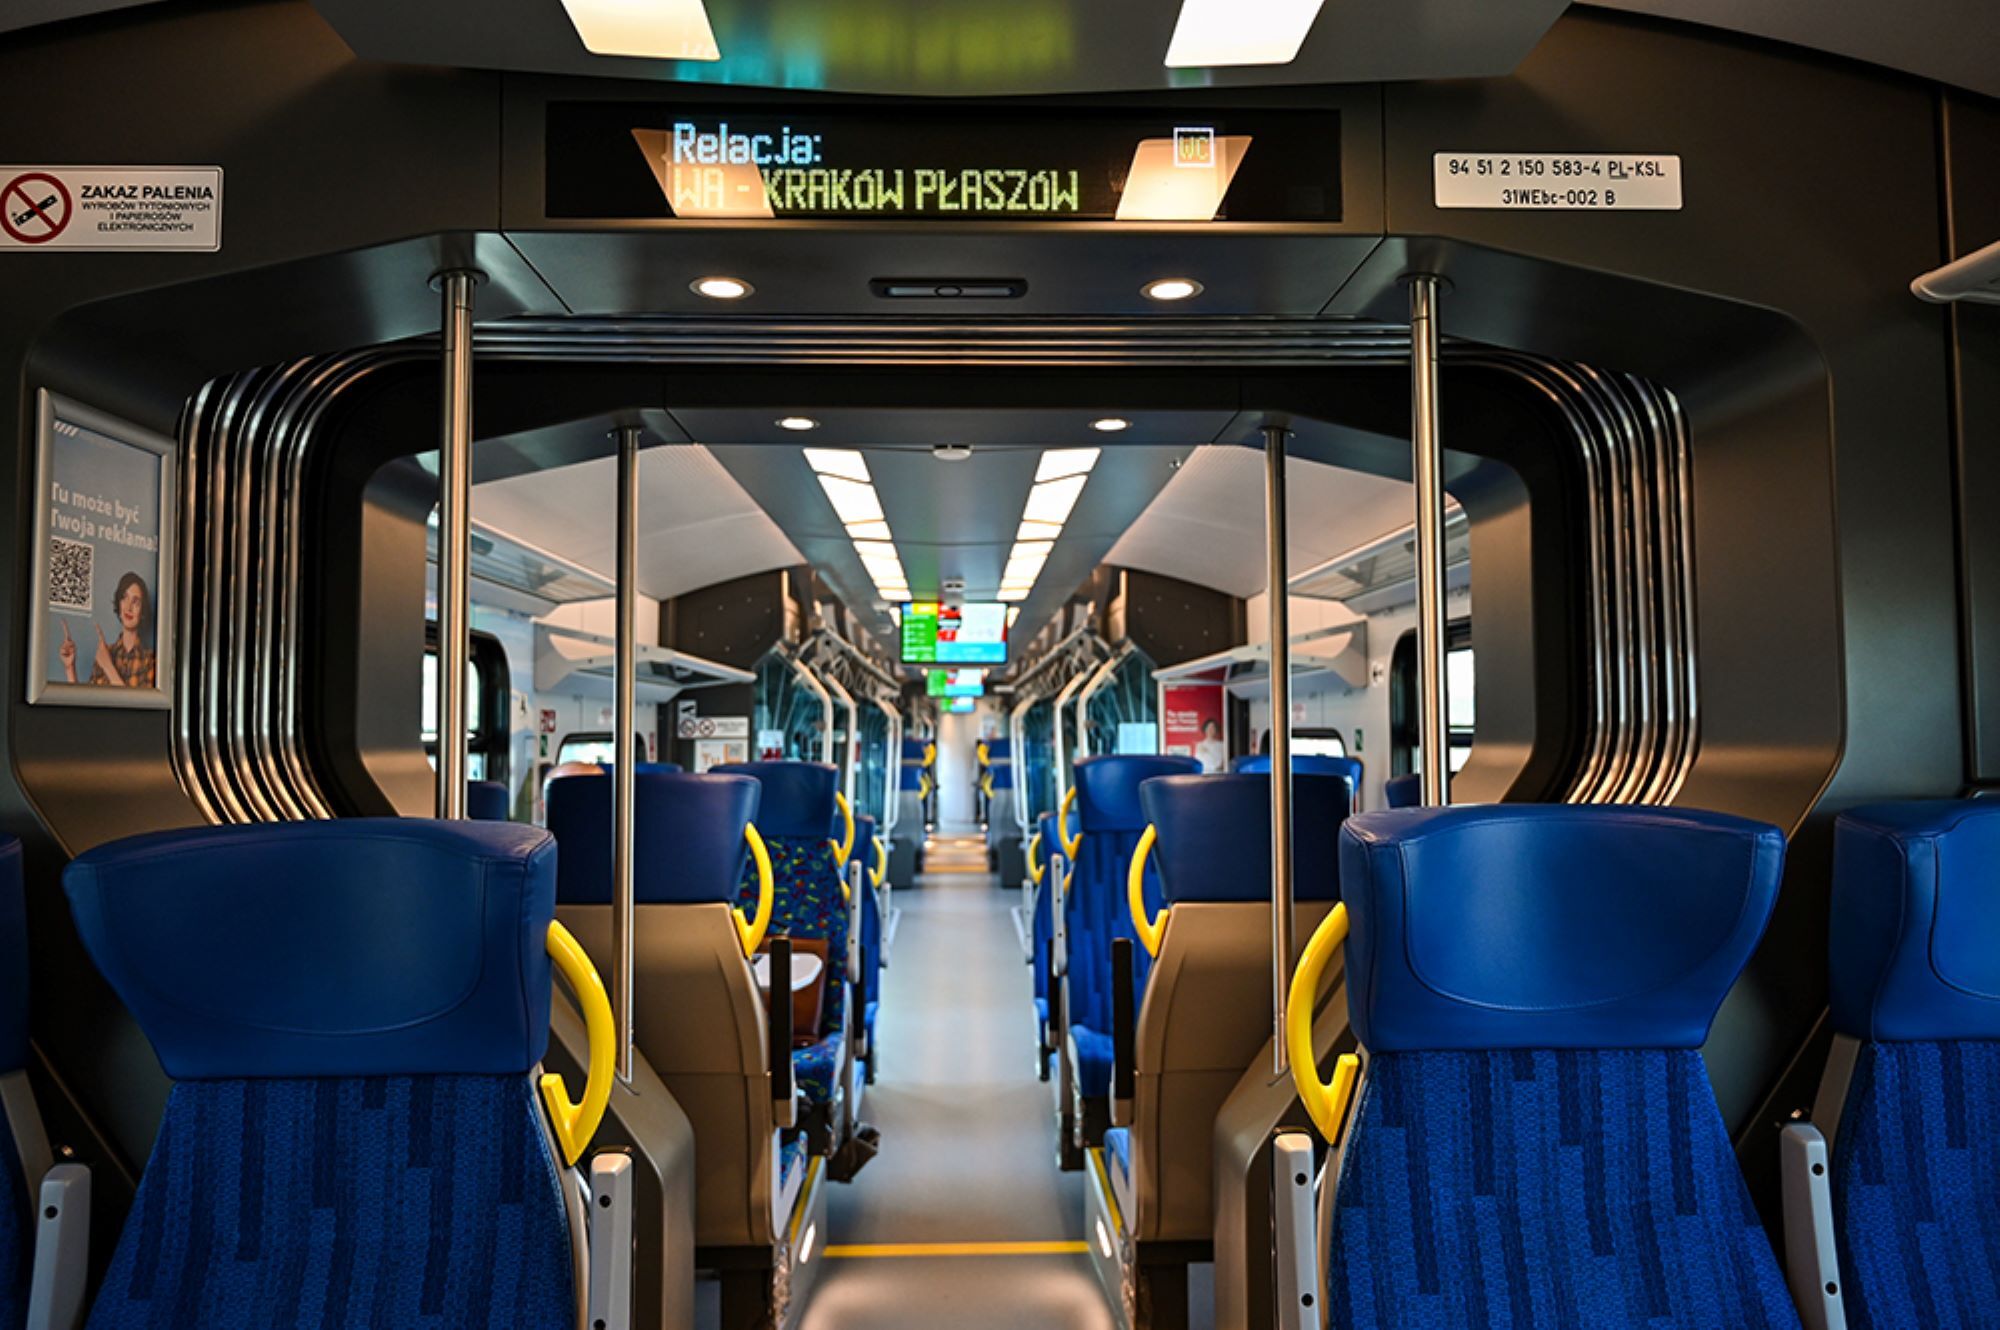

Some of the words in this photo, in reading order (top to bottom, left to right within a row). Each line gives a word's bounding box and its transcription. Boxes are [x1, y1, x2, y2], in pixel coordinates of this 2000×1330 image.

[673, 123, 822, 165] Relacja:
[1179, 136, 1209, 161] WC
[1449, 159, 1469, 175] 94
[1477, 159, 1493, 175] 51
[1501, 160, 1511, 176] 2
[1518, 160, 1545, 176] 150
[1552, 160, 1601, 176] 583-4
[1608, 160, 1665, 179] PL-KSL
[81, 185, 138, 198] ZAKAZ
[143, 186, 214, 199] PALENIA
[673, 167, 725, 210] WA
[762, 168, 904, 210] KRAKÓW
[915, 168, 1079, 211] PŁASZÓW
[1502, 189, 1598, 205] 31WEbc-002
[1605, 190, 1616, 205] B
[82, 201, 136, 210] WYROBÓW
[139, 201, 210, 211] TYTONIOWYCH
[115, 211, 181, 221] PAPIEROSÓW
[97, 222, 194, 232] ELEKTRONICZNYCH
[52, 481, 68, 504] Tu
[72, 494, 112, 516] może
[115, 499, 139, 525] być
[51, 508, 95, 538] Twoja
